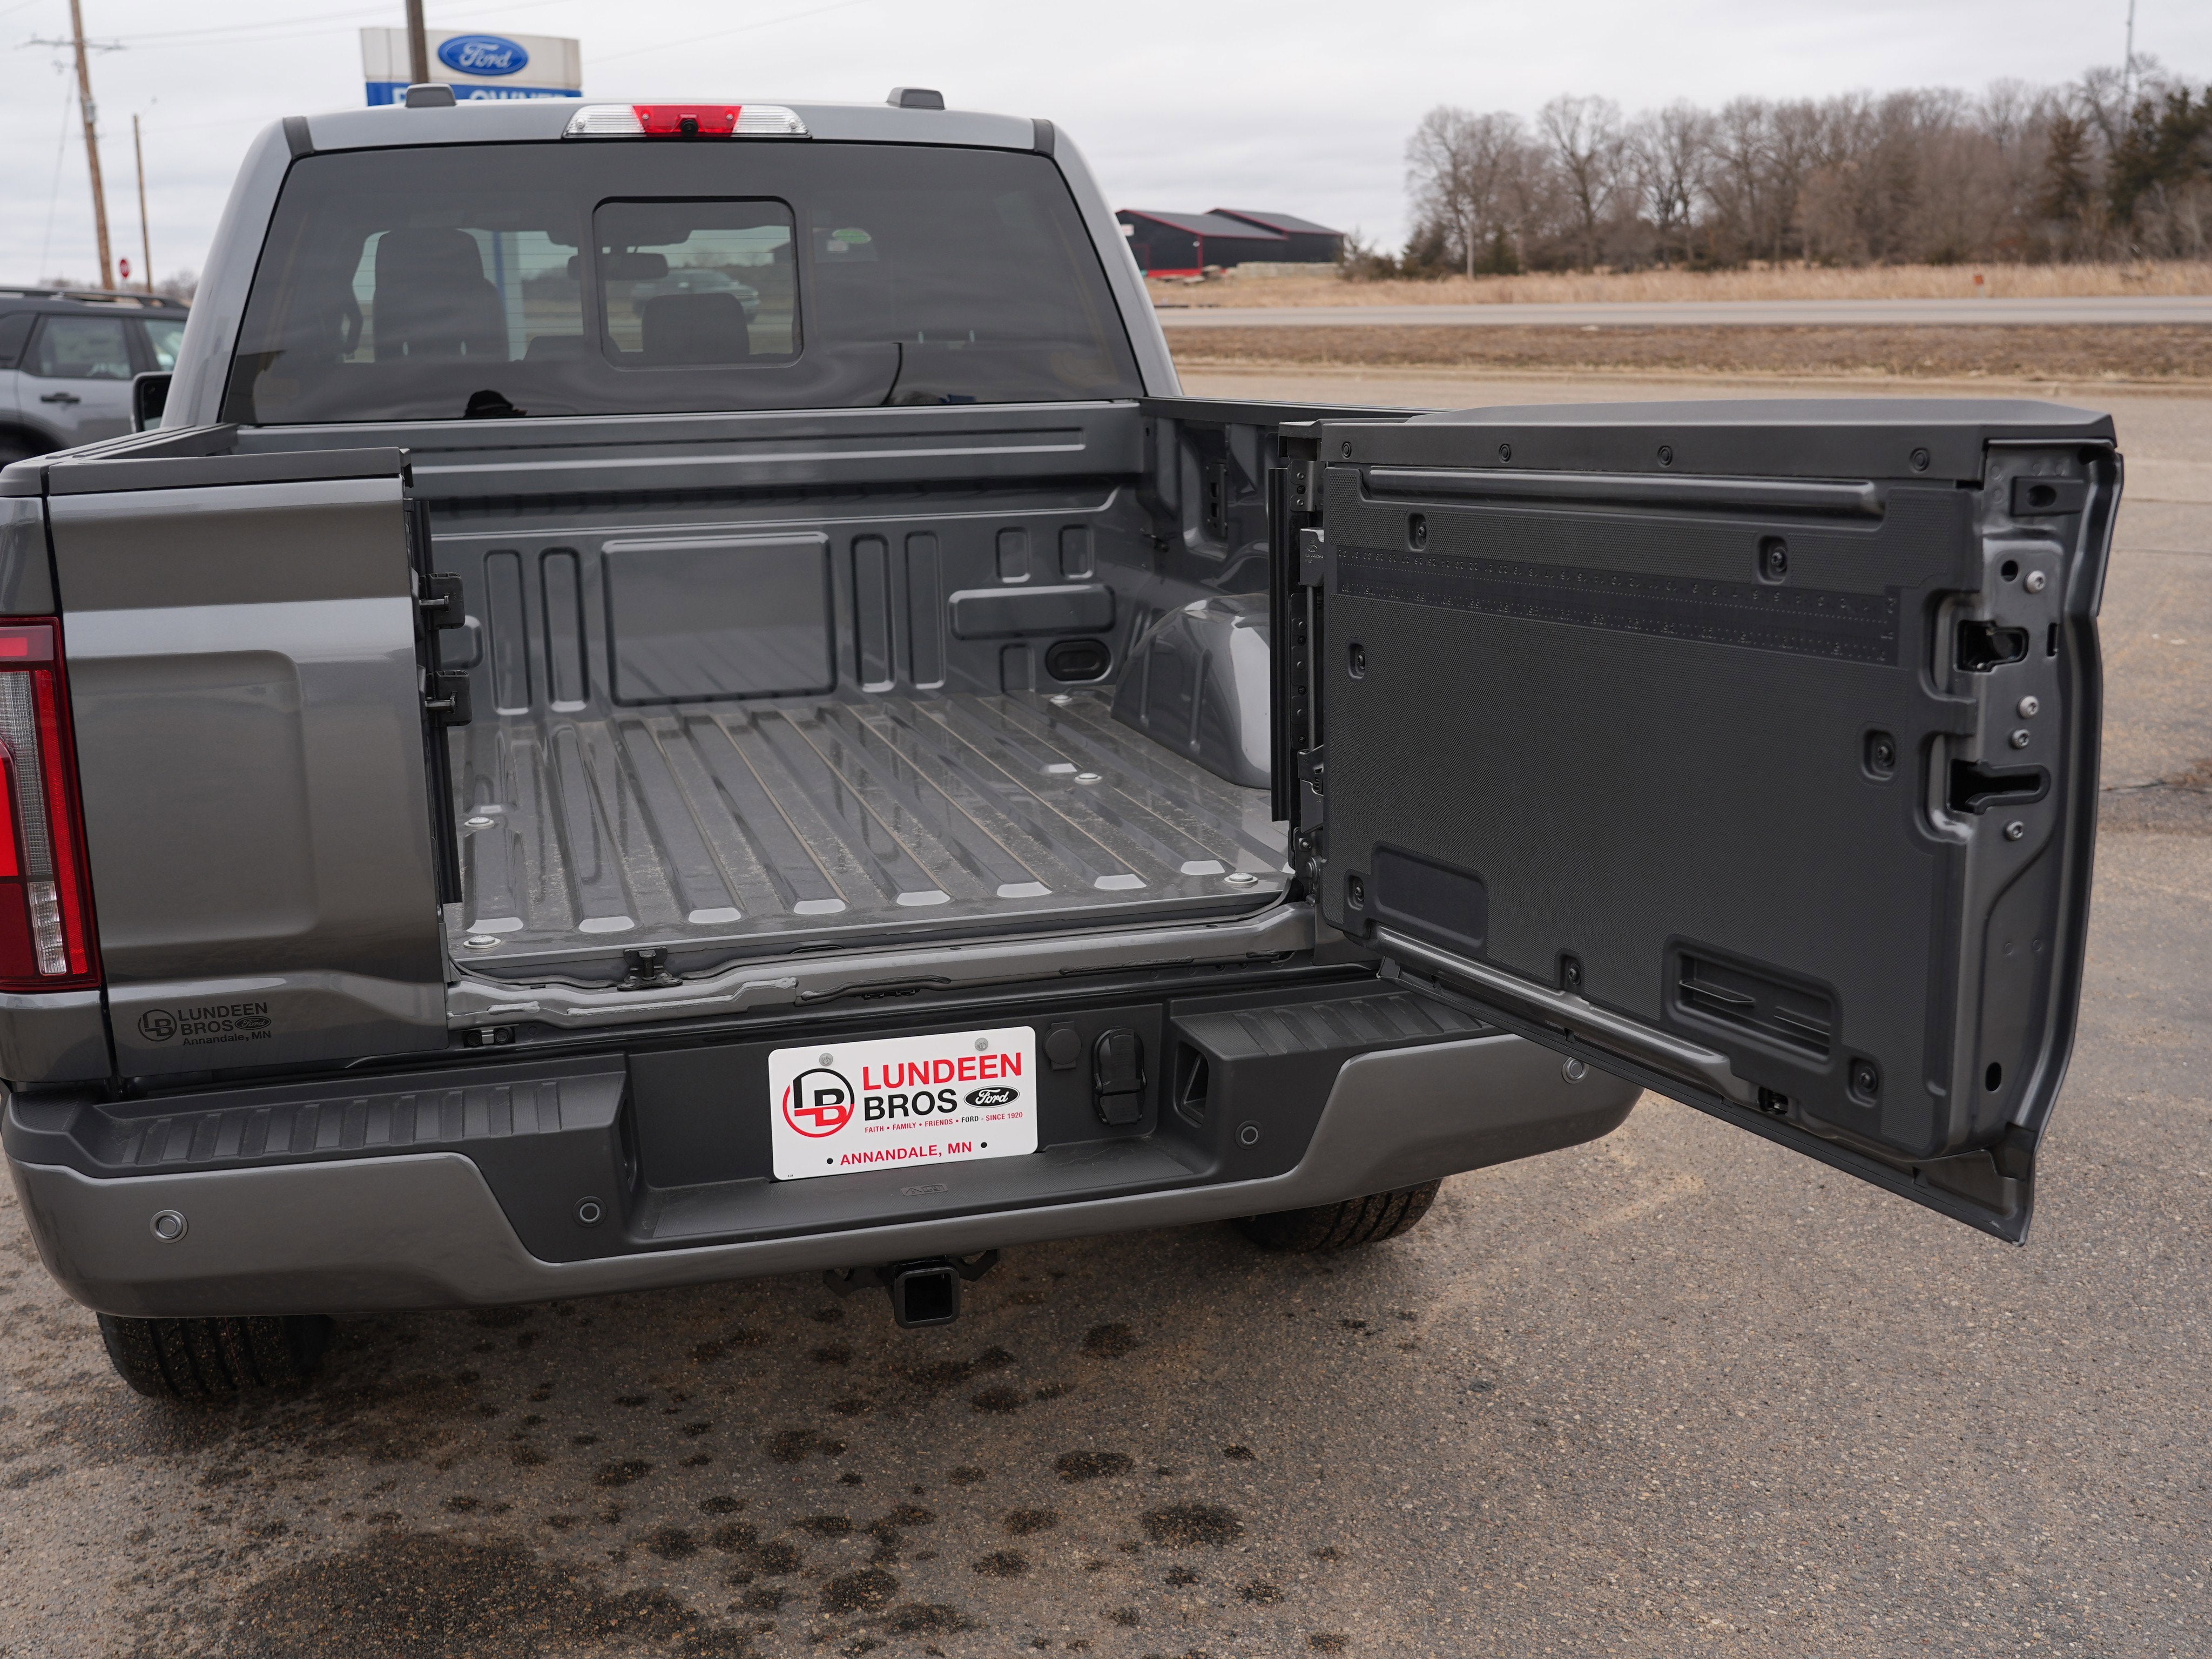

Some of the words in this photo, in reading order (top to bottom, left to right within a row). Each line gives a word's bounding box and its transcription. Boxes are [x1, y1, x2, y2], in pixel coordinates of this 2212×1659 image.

[459, 43, 512, 68] Ford
[178, 1002, 268, 1021] LUNDEEN
[181, 1020, 233, 1035] BROS
[241, 1019, 265, 1027] Ford
[183, 1034, 249, 1046] Annandale,
[252, 1030, 271, 1040] MN
[863, 1053, 1021, 1090] LUNDEEN
[865, 1089, 957, 1121] BROS
[975, 1089, 1009, 1105] Ford
[893, 1122, 916, 1130] FAMILY
[925, 1118, 953, 1127] FRIENDS
[840, 1144, 942, 1165] ANNANDALE,
[948, 1141, 972, 1154] MN
